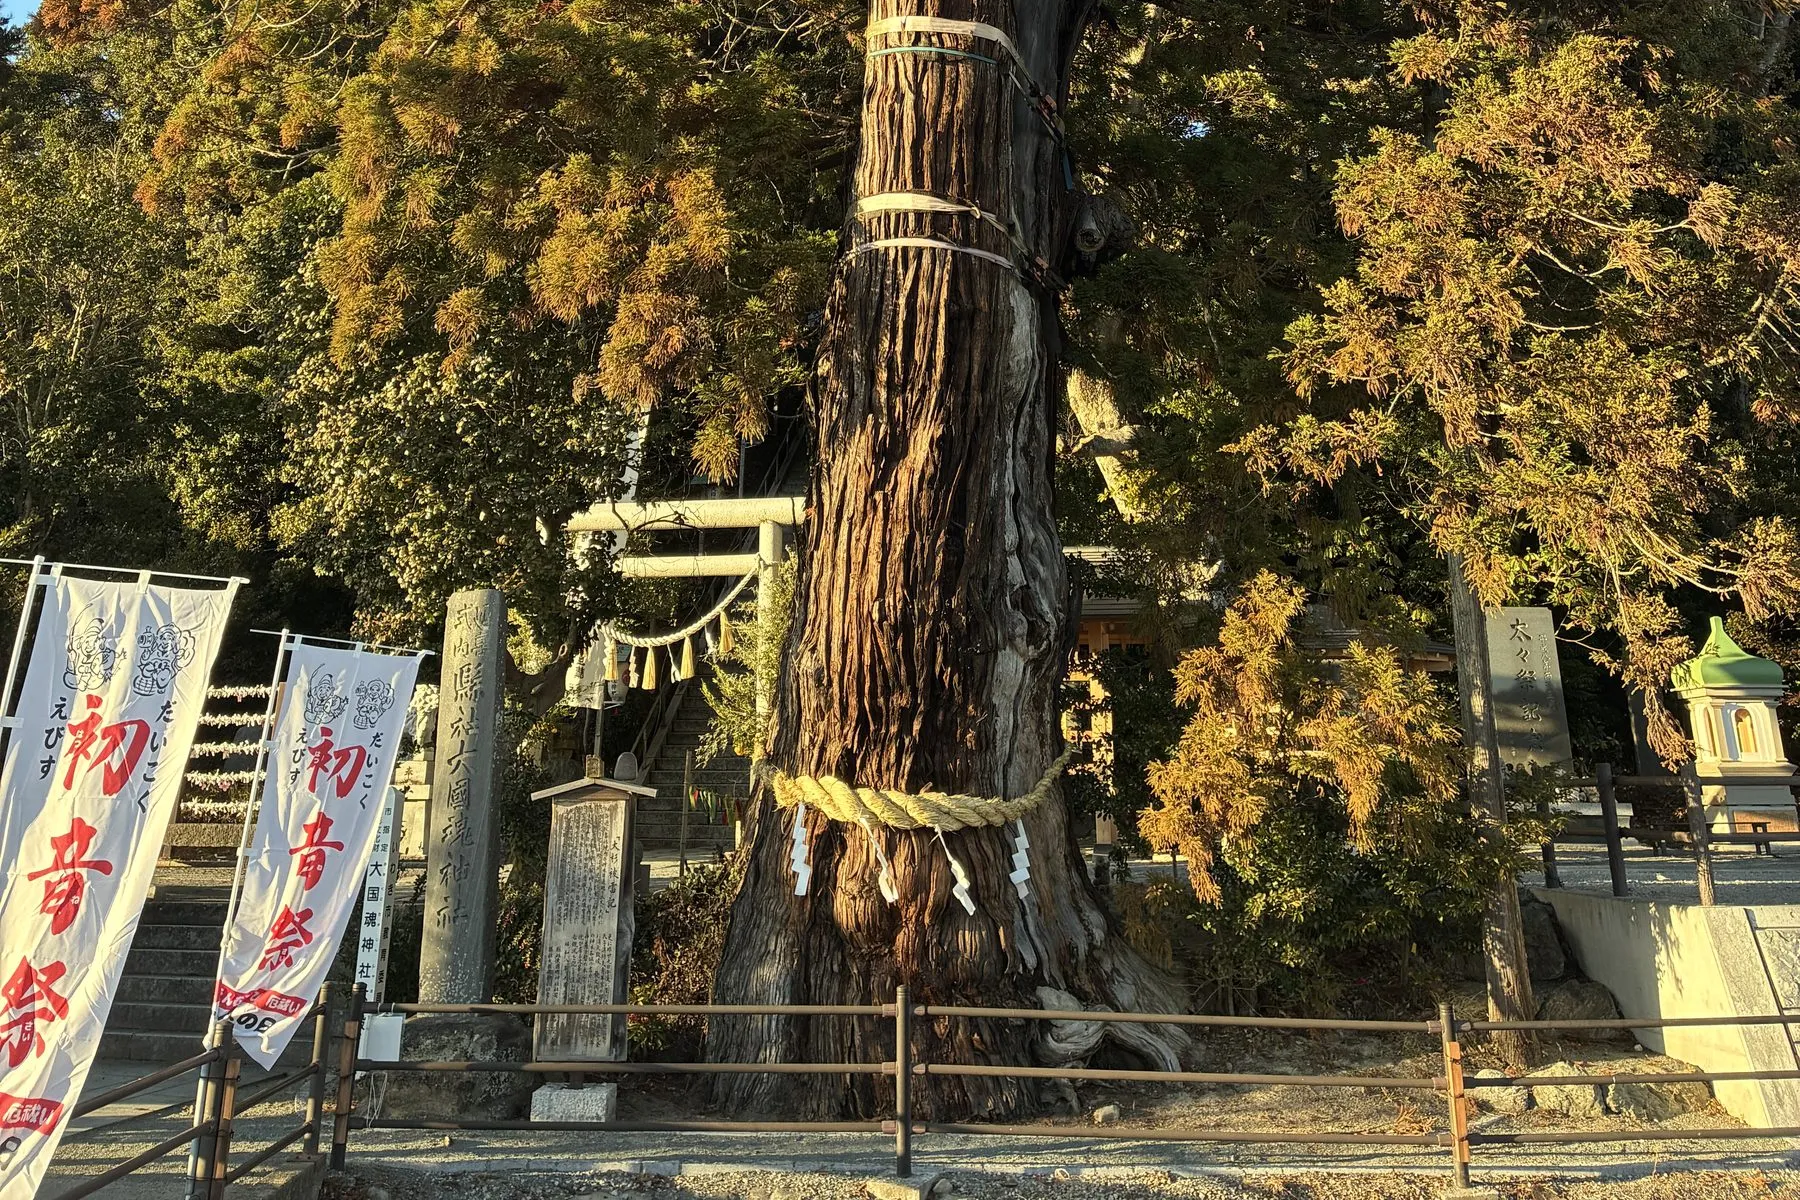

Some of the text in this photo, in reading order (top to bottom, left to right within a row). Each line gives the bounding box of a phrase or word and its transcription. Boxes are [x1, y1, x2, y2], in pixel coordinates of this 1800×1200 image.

[40, 696, 68, 781] えびす
[137, 700, 177, 814] だいこく
[290, 727, 308, 785] えびす
[359, 731, 384, 810] だいこく
[258, 726, 367, 972] 初音祭
[381, 807, 392, 853] 市指定
[0, 693, 151, 1069] 初音祭
[359, 860, 383, 980] 大国魂神社
[22, 1020, 34, 1042] さい
[265, 994, 300, 1014] 厄祓い
[2, 1102, 54, 1126] 厄祓い
